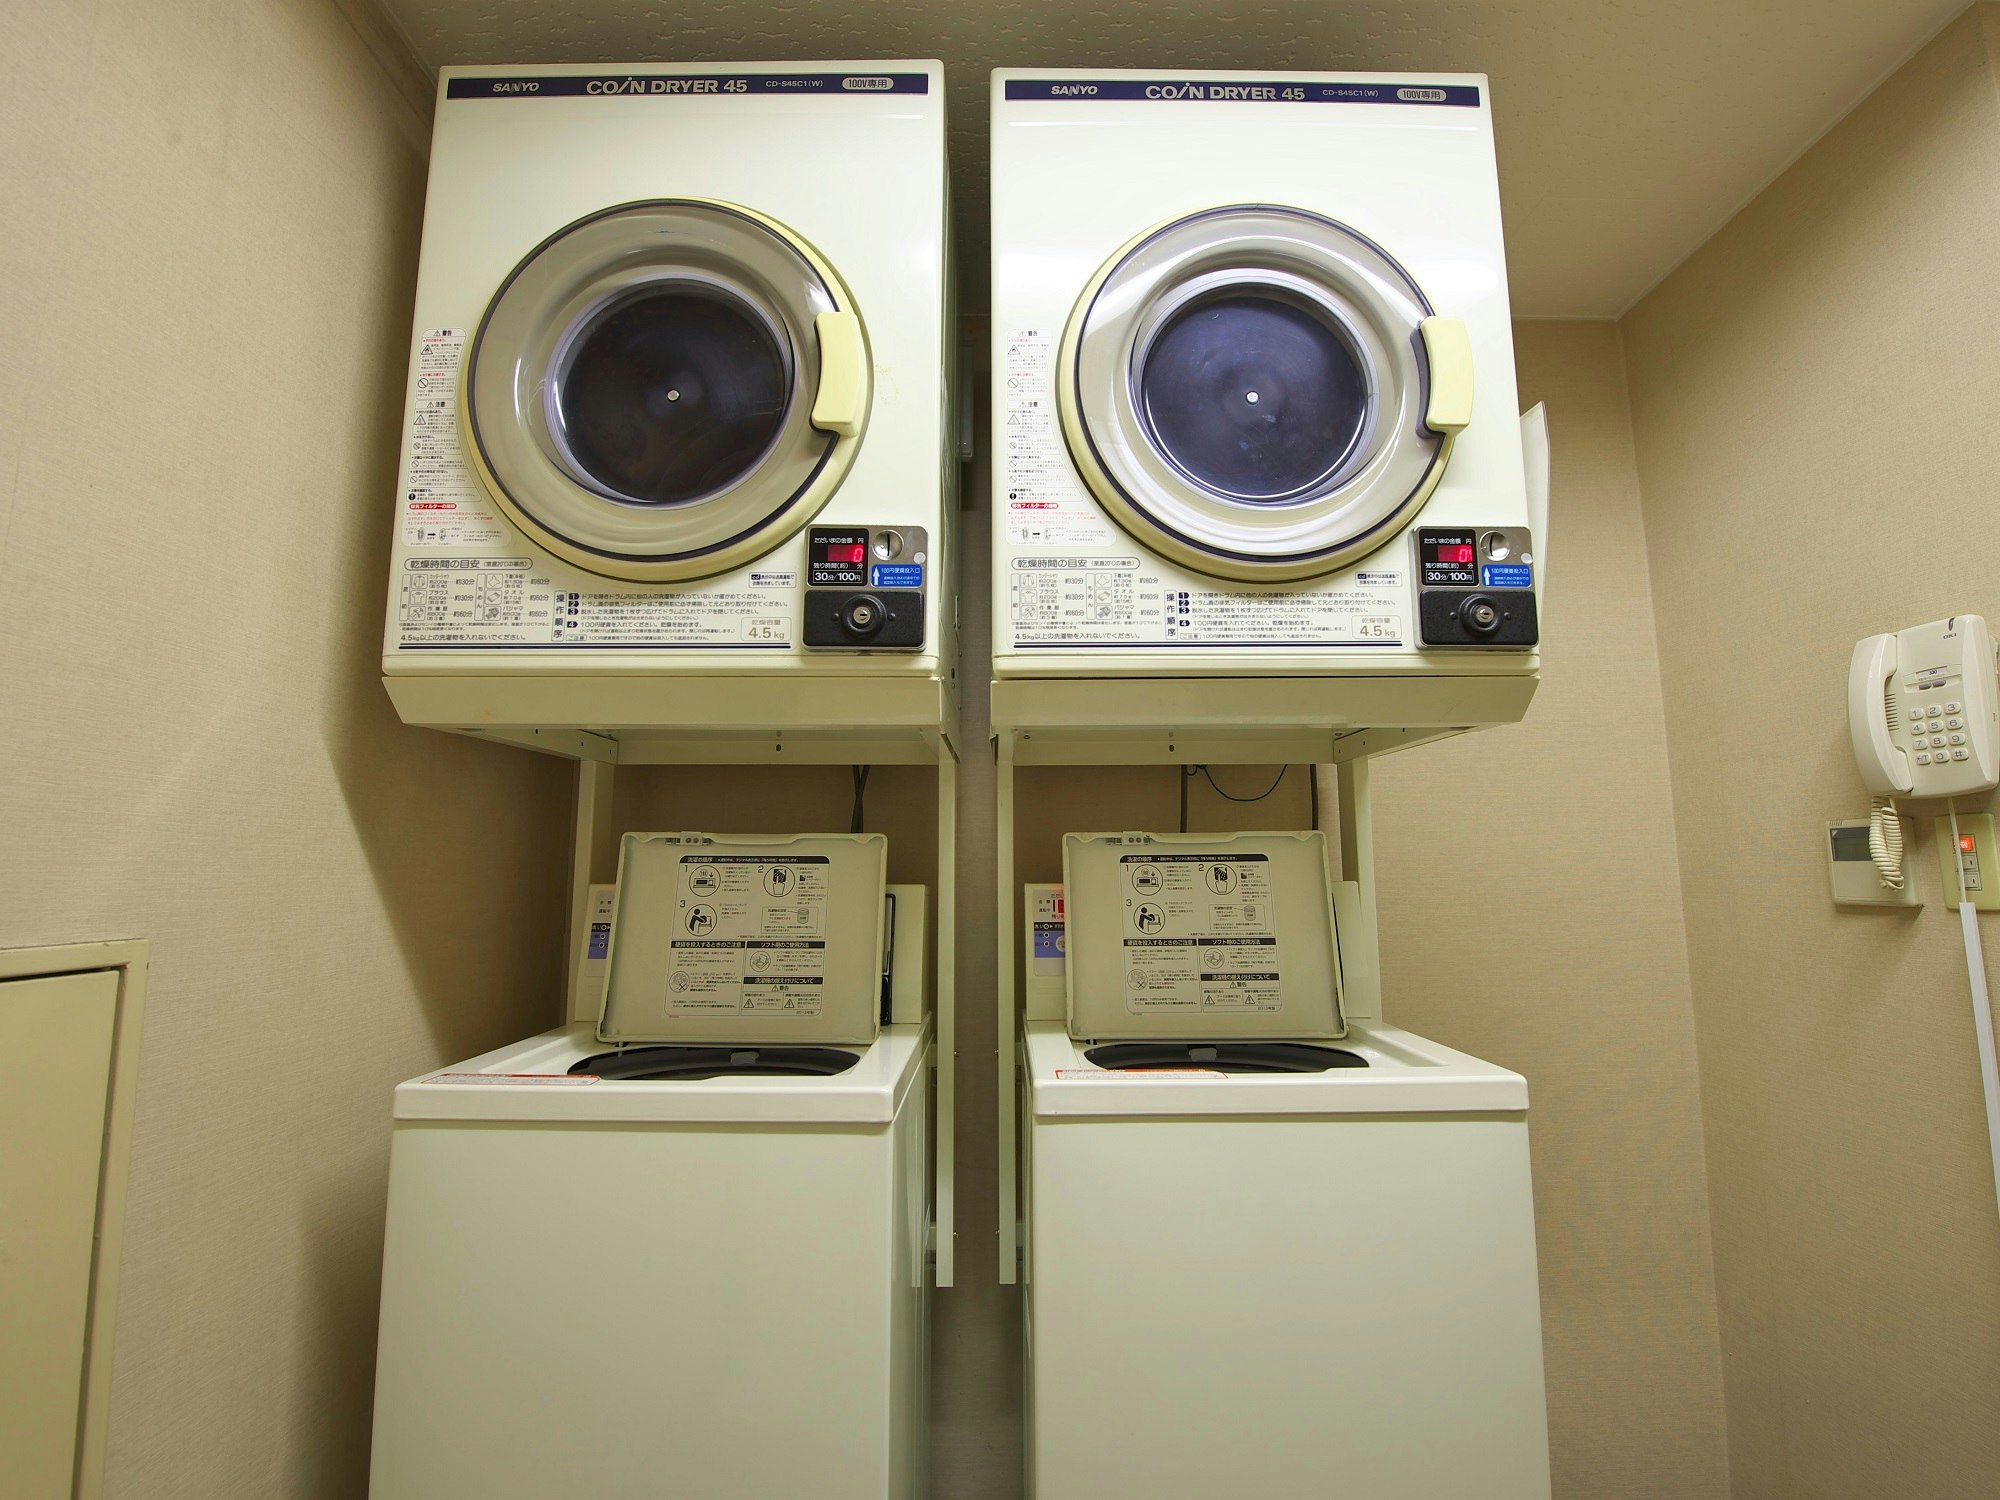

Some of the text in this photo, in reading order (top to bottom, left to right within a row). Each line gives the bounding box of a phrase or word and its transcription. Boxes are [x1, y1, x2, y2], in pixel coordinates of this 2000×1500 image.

[492, 81, 540, 92] SANYO
[650, 79, 719, 93] DRYER
[724, 79, 748, 93] 45
[765, 79, 824, 88] CD-S45C1(W)
[847, 77, 888, 89] 100V専用
[1050, 84, 1098, 95] SANYO
[1210, 85, 1277, 100] DRYER
[1281, 86, 1305, 101] 45
[1322, 88, 1379, 98] CD-S45C1(W)
[1402, 88, 1441, 100] 100V専用
[410, 559, 480, 569] 乾燥時間の目安
[1017, 559, 1087, 568] 乾燥時間の目安
[814, 572, 861, 581] 30分/100円
[1427, 572, 1473, 581] 30分/100円
[748, 626, 785, 640] 4.5 kg
[1014, 632, 1140, 640] 4.5kg以上の洗濯物を入れないでください。
[1359, 625, 1396, 638] 4.5 kg
[1943, 632, 1957, 640] OKI
[1929, 706, 1937, 714] 2
[1947, 703, 1956, 711] 3
[1930, 721, 1938, 729] 5
[1949, 719, 1957, 727] 6
[1933, 737, 1941, 745] 8
[1936, 752, 1944, 760] 0
[684, 864, 688, 872] 1
[757, 865, 764, 873] 2
[1125, 864, 1129, 872] 1
[1198, 863, 1205, 871] 2
[679, 900, 686, 908] 3
[1125, 898, 1132, 907] 3
